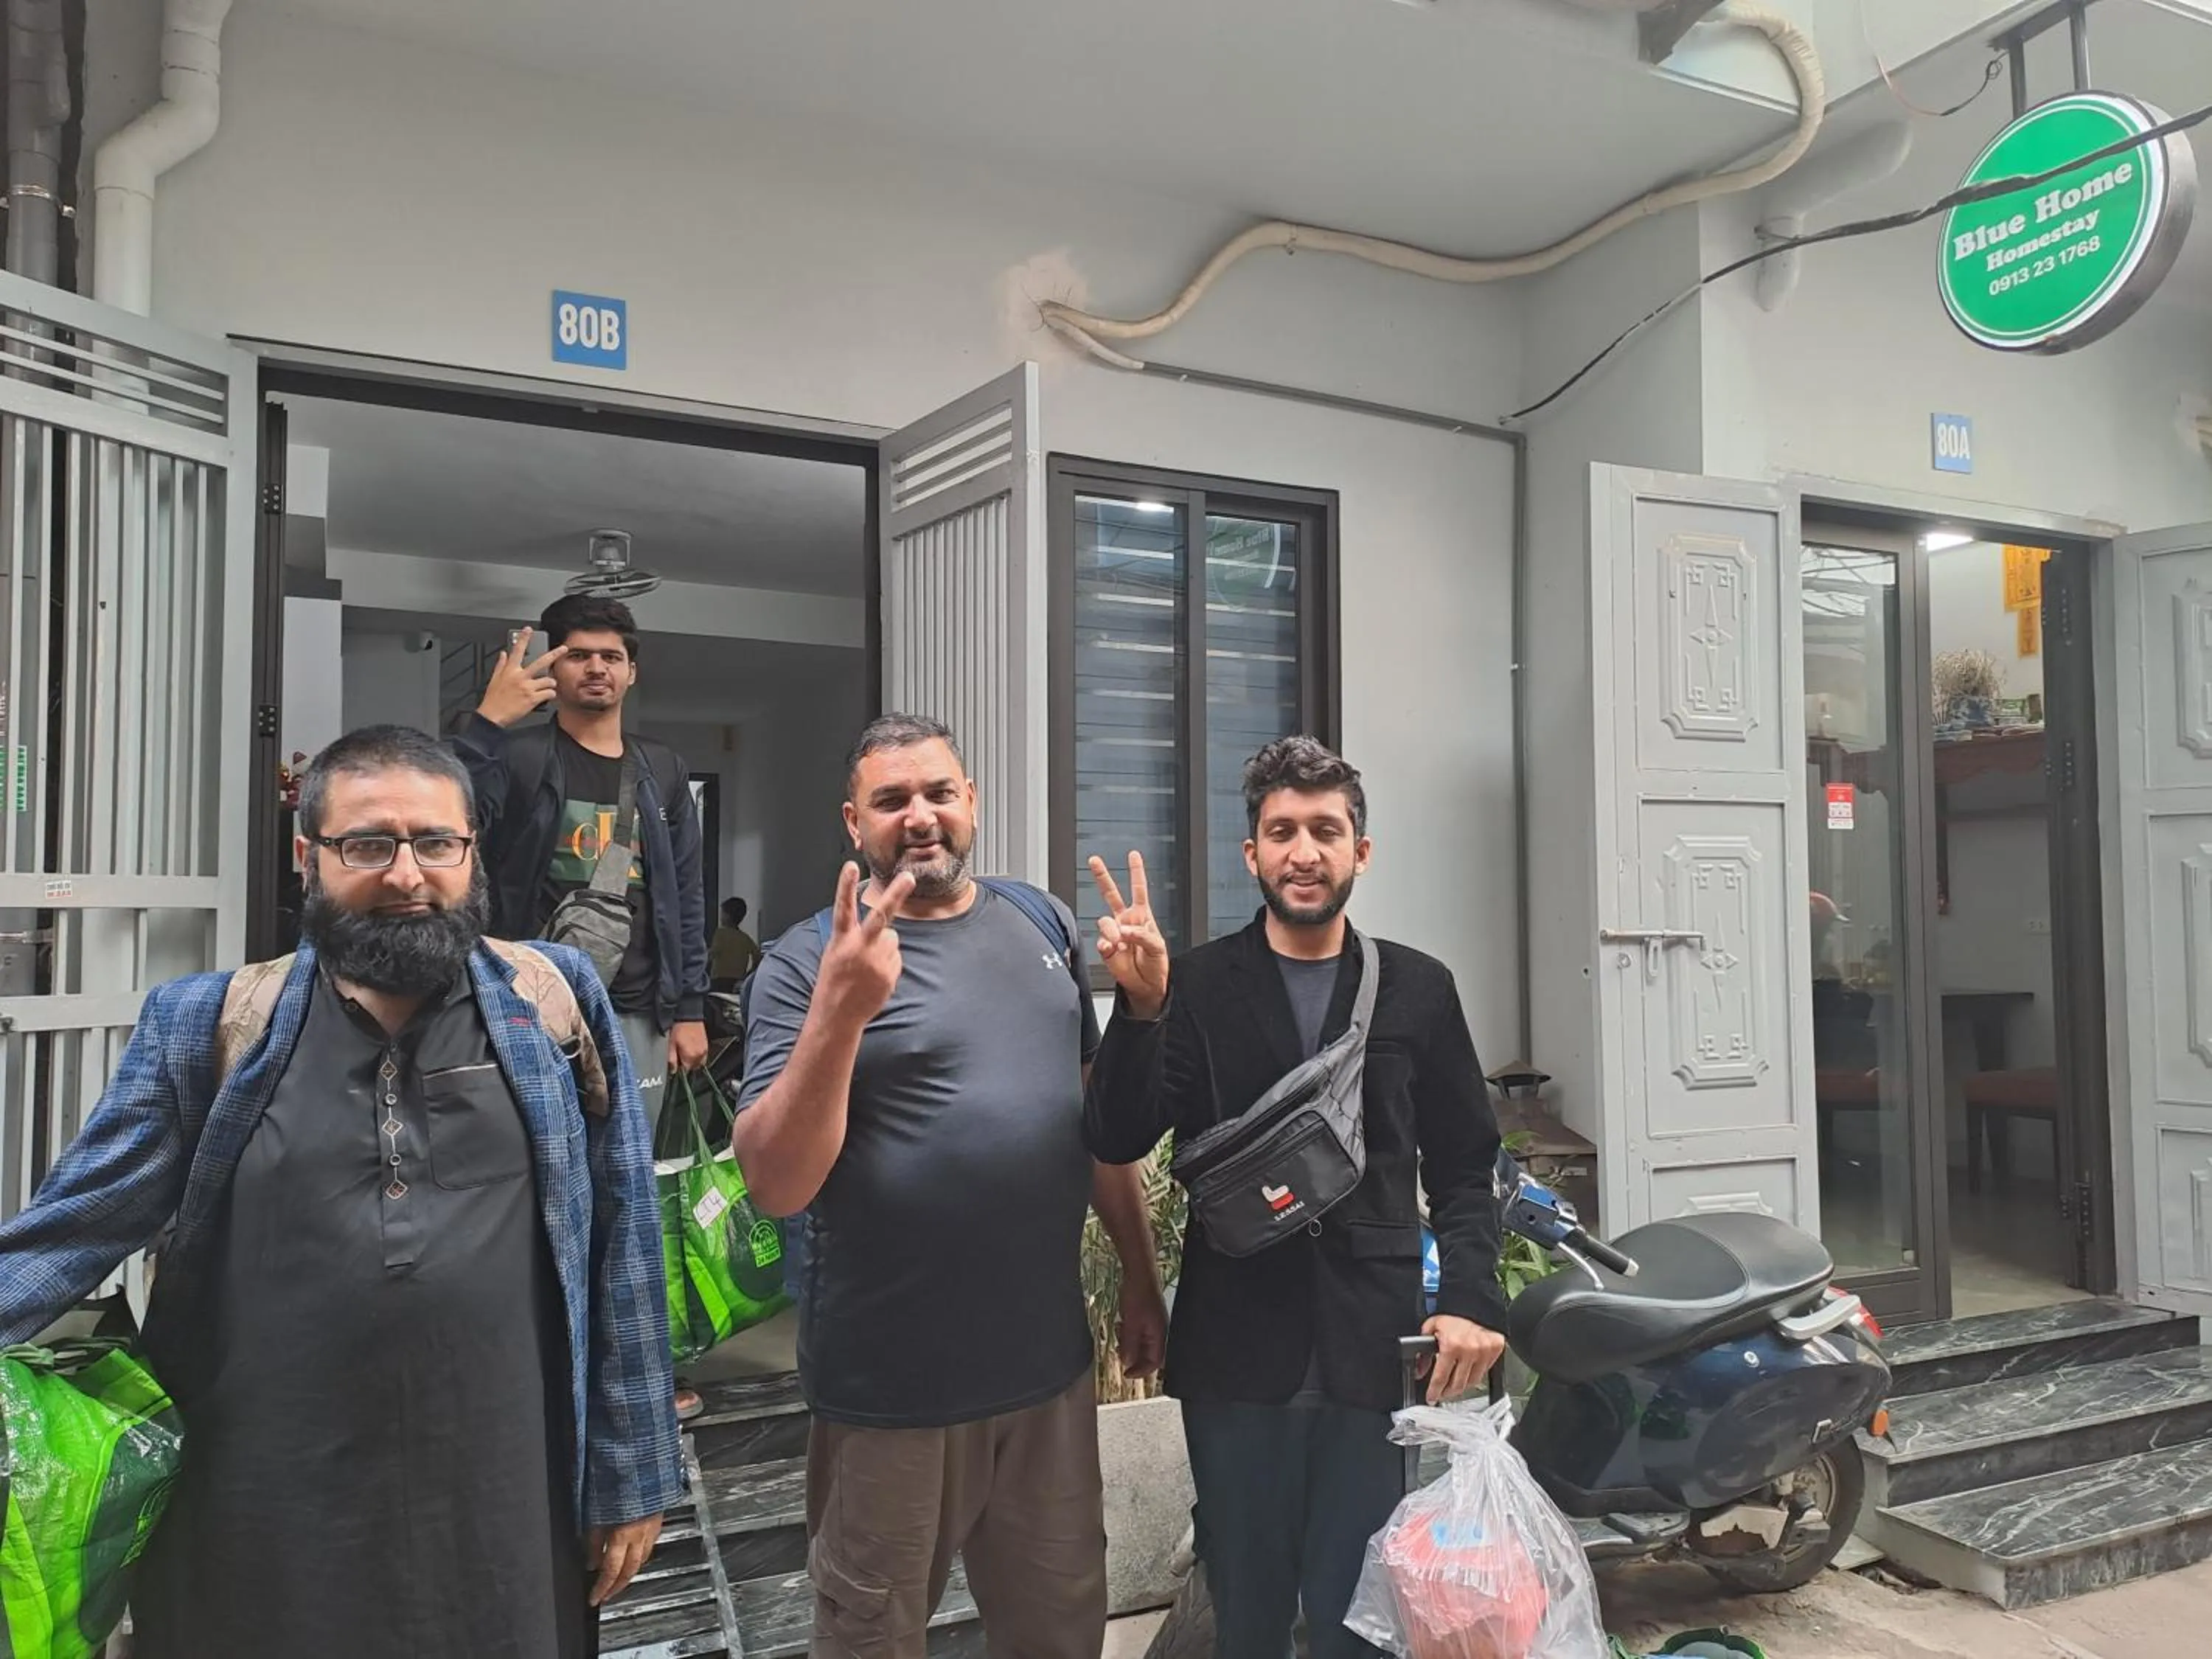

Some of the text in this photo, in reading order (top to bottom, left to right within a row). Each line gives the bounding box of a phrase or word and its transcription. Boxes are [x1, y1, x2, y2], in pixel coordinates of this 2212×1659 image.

[1953, 162, 2133, 260] Blue Home
[1986, 209, 2100, 271] Homestay
[1989, 234, 2101, 296] 0913 23 1768
[559, 303, 620, 350] 80B
[1937, 422, 1971, 460] 80A
